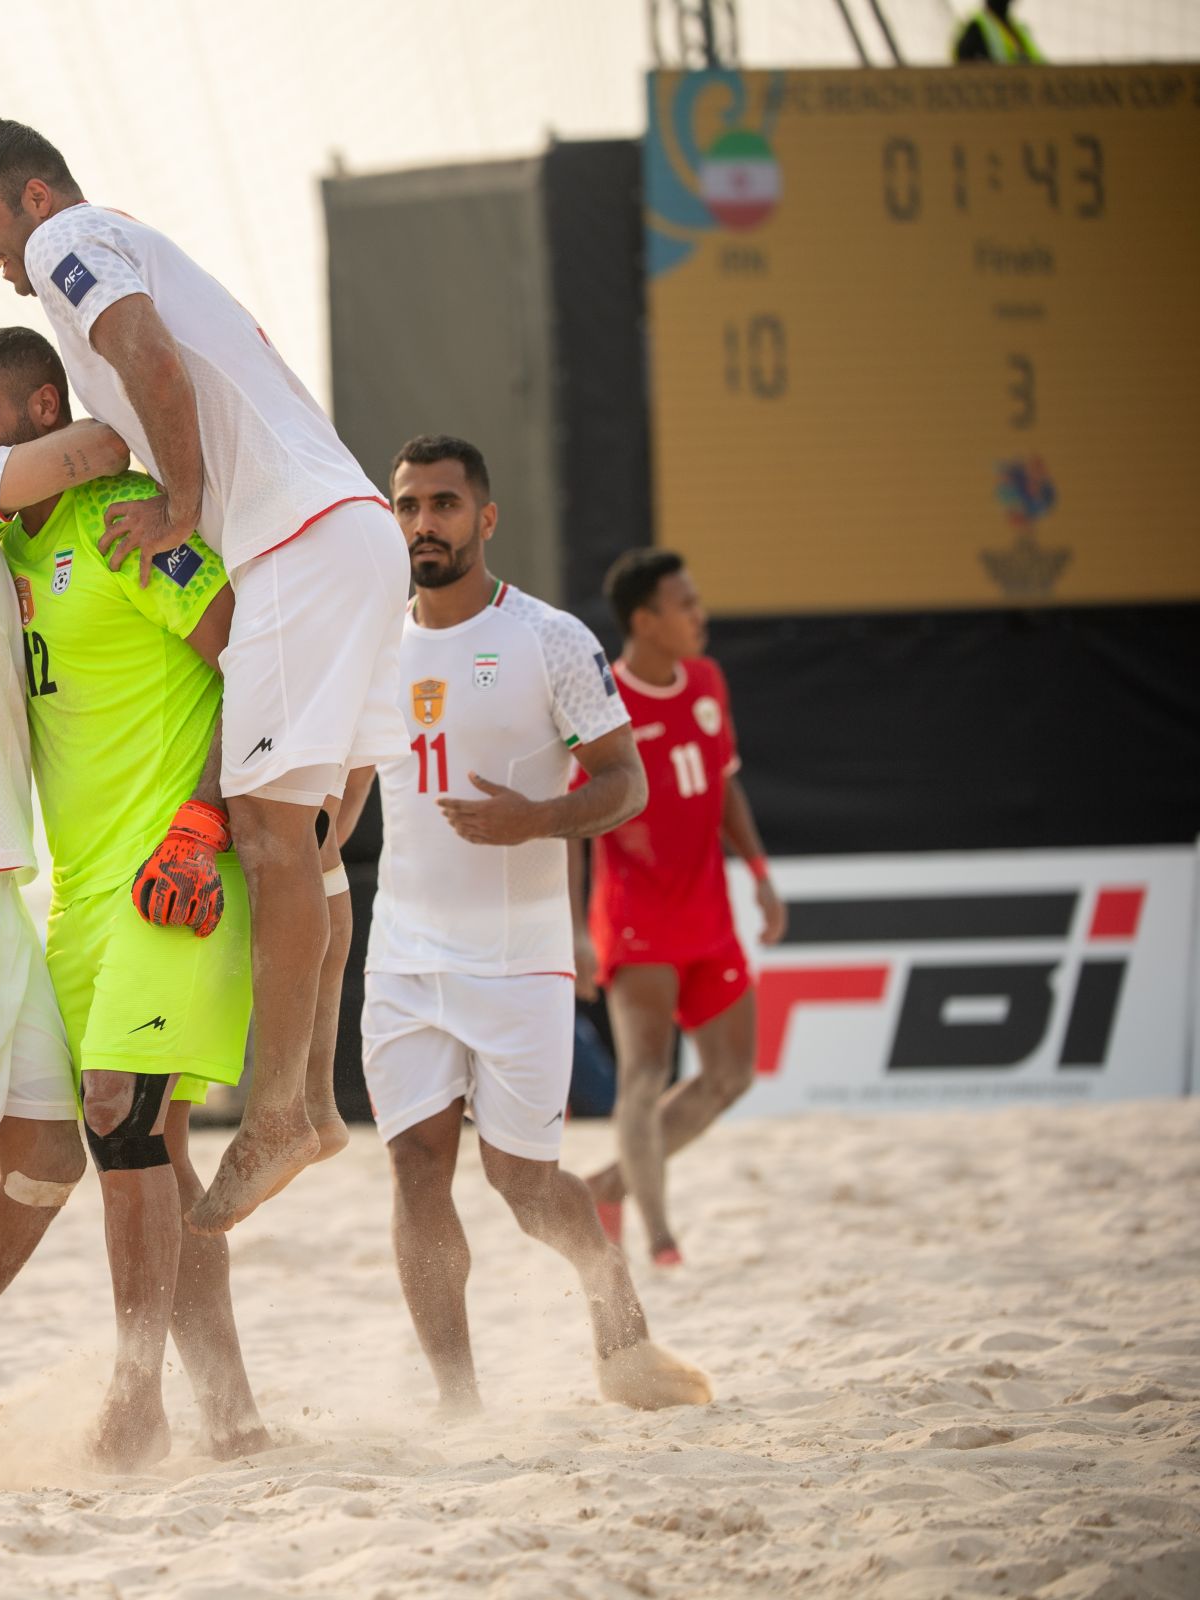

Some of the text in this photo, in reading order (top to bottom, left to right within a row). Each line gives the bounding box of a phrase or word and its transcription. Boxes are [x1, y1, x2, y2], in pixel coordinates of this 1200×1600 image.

[883, 132, 1105, 221] 01:43
[64, 264, 84, 293] AFC
[723, 315, 788, 399] 10
[1007, 354, 1037, 430] 3
[23, 630, 59, 698] 12
[410, 732, 448, 794] 11
[669, 741, 709, 799] 11
